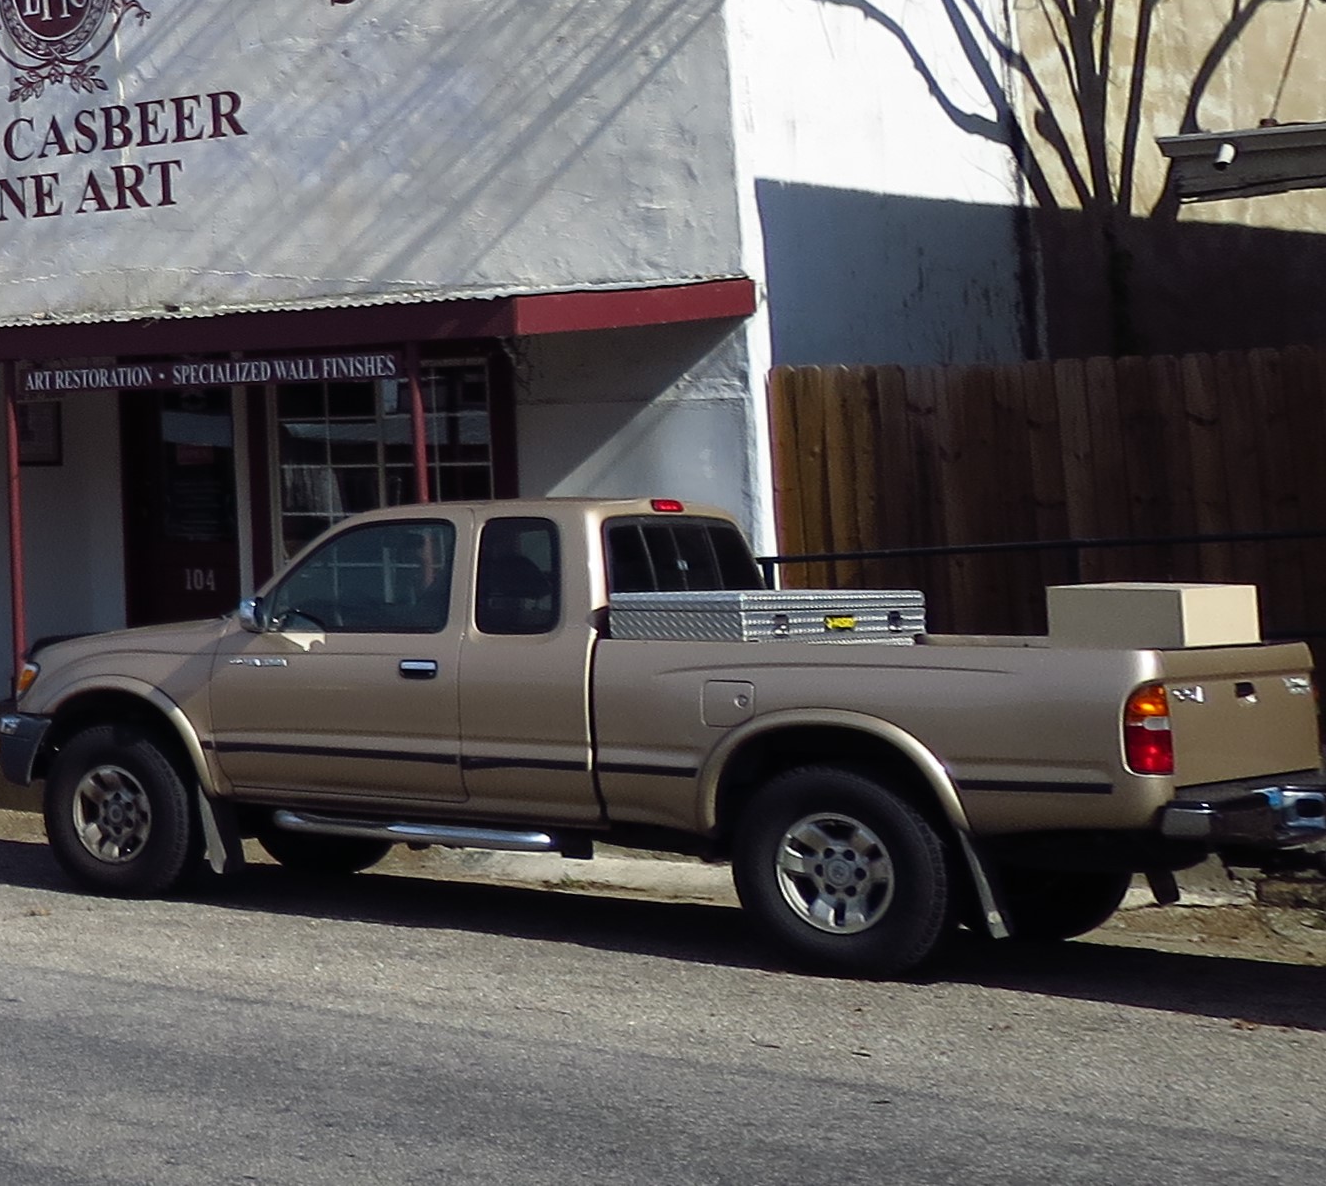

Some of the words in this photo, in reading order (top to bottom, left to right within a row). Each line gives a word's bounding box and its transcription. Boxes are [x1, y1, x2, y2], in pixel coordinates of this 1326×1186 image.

[3, 90, 248, 162] CASBEER
[75, 160, 182, 214] ART
[25, 370, 53, 391] ART
[55, 366, 153, 390] RESTORATION
[172, 360, 271, 385] SPECIALIZED
[273, 359, 319, 381] WALL
[322, 355, 396, 379] FINISHES
[185, 569, 216, 591] 104
